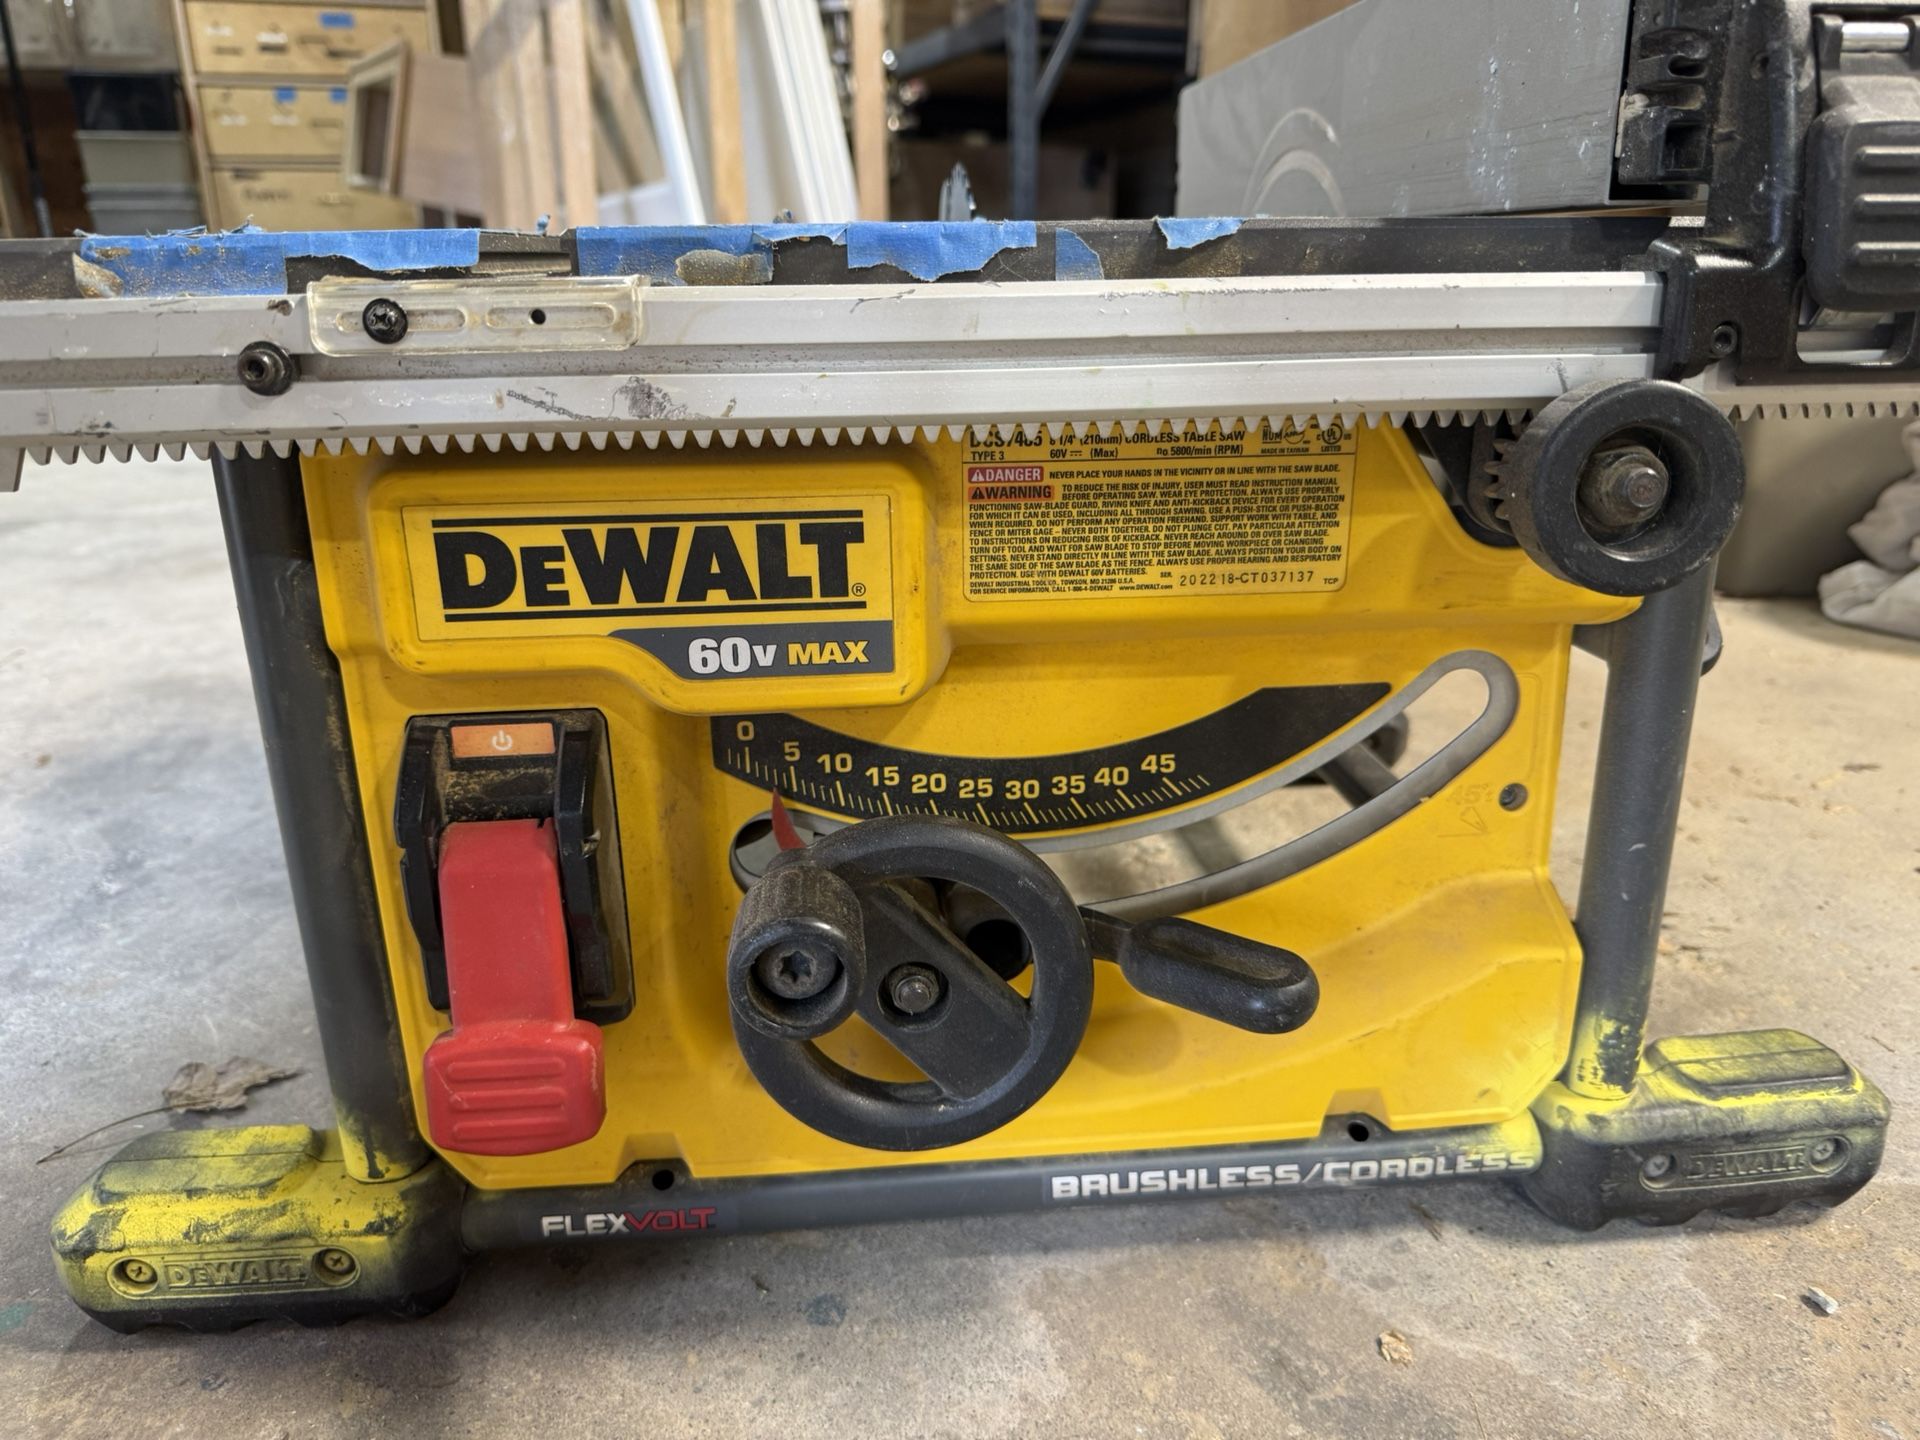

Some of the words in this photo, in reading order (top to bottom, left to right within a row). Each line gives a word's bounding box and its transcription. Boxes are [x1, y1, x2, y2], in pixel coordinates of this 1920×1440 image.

[1183, 431, 1216, 442] TABLE
[1218, 430, 1245, 441] SAW
[971, 452, 996, 460] TYPE
[998, 452, 1004, 460] 3
[1050, 448, 1067, 458] 60V
[1090, 448, 1118, 458] (Max)
[1171, 446, 1212, 456] 5800/min
[1214, 444, 1243, 456] (RPM)
[986, 468, 1041, 482] DANGER
[1050, 471, 1074, 479] NEVER
[1076, 470, 1100, 478] PLACE
[1102, 470, 1122, 478] YOUR
[1124, 469, 1151, 477] HANDS
[1180, 468, 1212, 476] VICINITY
[1237, 467, 1253, 475] LINE
[1255, 466, 1275, 474] WITH
[985, 486, 1052, 499] WARNING
[1074, 483, 1103, 492] REDUCE
[1184, 481, 1203, 489] USER
[1205, 481, 1227, 489] MUST
[1229, 480, 1249, 488] READ
[1251, 479, 1302, 488] INSTRUCTION
[1304, 478, 1337, 486] MANUAL
[1062, 492, 1090, 500] BEFORE
[1092, 491, 1135, 499] OPERATING
[1159, 490, 1182, 498] WEAR
[1250, 488, 1282, 496] ALWAYS
[1301, 487, 1339, 495] PROPERLY
[970, 503, 1021, 511] FUNCTIONING
[1023, 502, 1069, 510] SAW-BLADE
[1171, 498, 1229, 506] ANTI-KICKBACK
[1232, 497, 1258, 505] DEVICE
[1276, 496, 1299, 504] EVERY
[1301, 495, 1344, 503] OPERATION
[986, 511, 1011, 519] WHICH
[1076, 509, 1117, 517] INCLUDING
[1135, 508, 1171, 516] THROUGH
[1232, 505, 1277, 513] PUSH-STICK
[1291, 504, 1339, 512] PUSH-BLOCK
[970, 520, 992, 528] WHEN
[1066, 518, 1102, 526] PERFORM
[1122, 516, 1165, 524] OPERATION
[1210, 514, 1244, 522] SUPPORT
[1271, 513, 1291, 521] WITH
[970, 529, 992, 537] FENCE
[1007, 528, 1030, 536] MITER
[1061, 527, 1085, 535] NEVER
[1088, 526, 1108, 534] BOTH
[1182, 524, 1211, 532] PLUNGE
[1249, 522, 1295, 530] PARTICULAR
[1297, 520, 1339, 529] ATTENTION
[981, 537, 1037, 545] INSTRUCTIONS
[1052, 535, 1090, 543] REDUCING
[1190, 532, 1214, 540] REACH
[1216, 531, 1248, 539] AROUND
[1262, 530, 1281, 538] OVER
[970, 546, 989, 554] TURN
[1007, 545, 1026, 553] TOOL
[1046, 544, 1066, 552] WAIT
[1163, 541, 1191, 549] BEFORE
[1193, 540, 1224, 548] MOVING
[1226, 539, 1269, 547] WORKPIECE
[1283, 538, 1324, 546] CHANGING
[1010, 553, 1034, 561] NEVER
[1064, 552, 1098, 560] DIRECTLY
[1129, 550, 1149, 558] WITH
[1214, 548, 1246, 556] ALWAYS
[1248, 547, 1283, 555] POSITION
[1285, 546, 1305, 554] YOUR
[433, 521, 865, 610] DEWALT
[1075, 560, 1099, 568] BLADE
[1156, 558, 1188, 566] ALWAYS
[1237, 556, 1270, 564] HEARING
[1290, 554, 1341, 562] RESPIRATORY
[1058, 569, 1088, 577] DEWALT
[788, 640, 869, 666] MAX
[736, 720, 754, 741] 0
[785, 742, 800, 762] 5
[817, 752, 852, 774] 10
[865, 766, 901, 788] 15
[911, 773, 947, 794] 20
[958, 777, 994, 798] 25
[1005, 778, 1040, 800] 30
[1051, 774, 1086, 796] 35
[1093, 766, 1130, 788] 40
[1140, 753, 1177, 775] 45
[1051, 1152, 1536, 1200] BRUSHLESS/CORDLESS
[542, 1206, 717, 1238] FLEXVOLT
[165, 1258, 304, 1287] DEWALT
